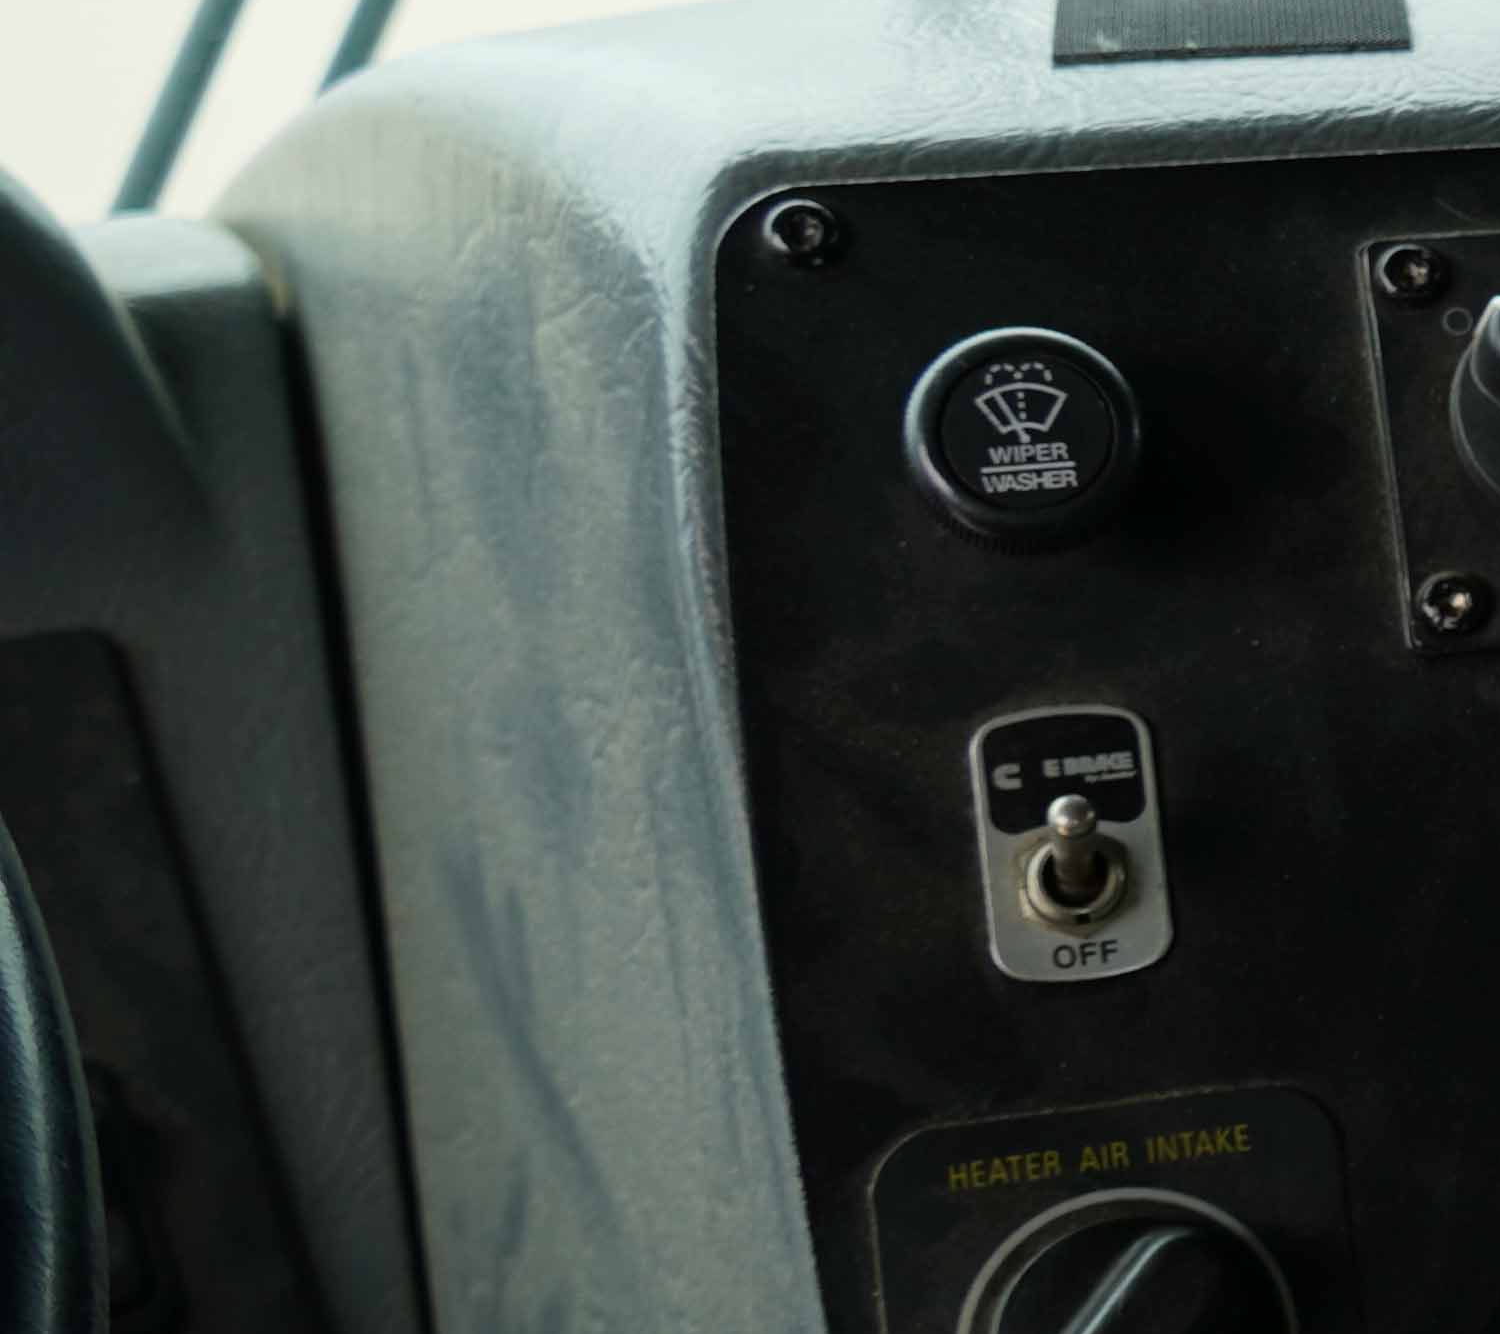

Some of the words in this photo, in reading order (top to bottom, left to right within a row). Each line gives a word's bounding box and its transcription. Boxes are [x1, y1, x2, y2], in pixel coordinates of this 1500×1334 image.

[988, 442, 1069, 464] WIPER
[982, 469, 1078, 493] WASHER
[1053, 940, 1118, 969] OFF
[946, 1150, 1063, 1192] HEATER
[1079, 1140, 1130, 1174] AIR
[1146, 1124, 1253, 1163] INTAKE
